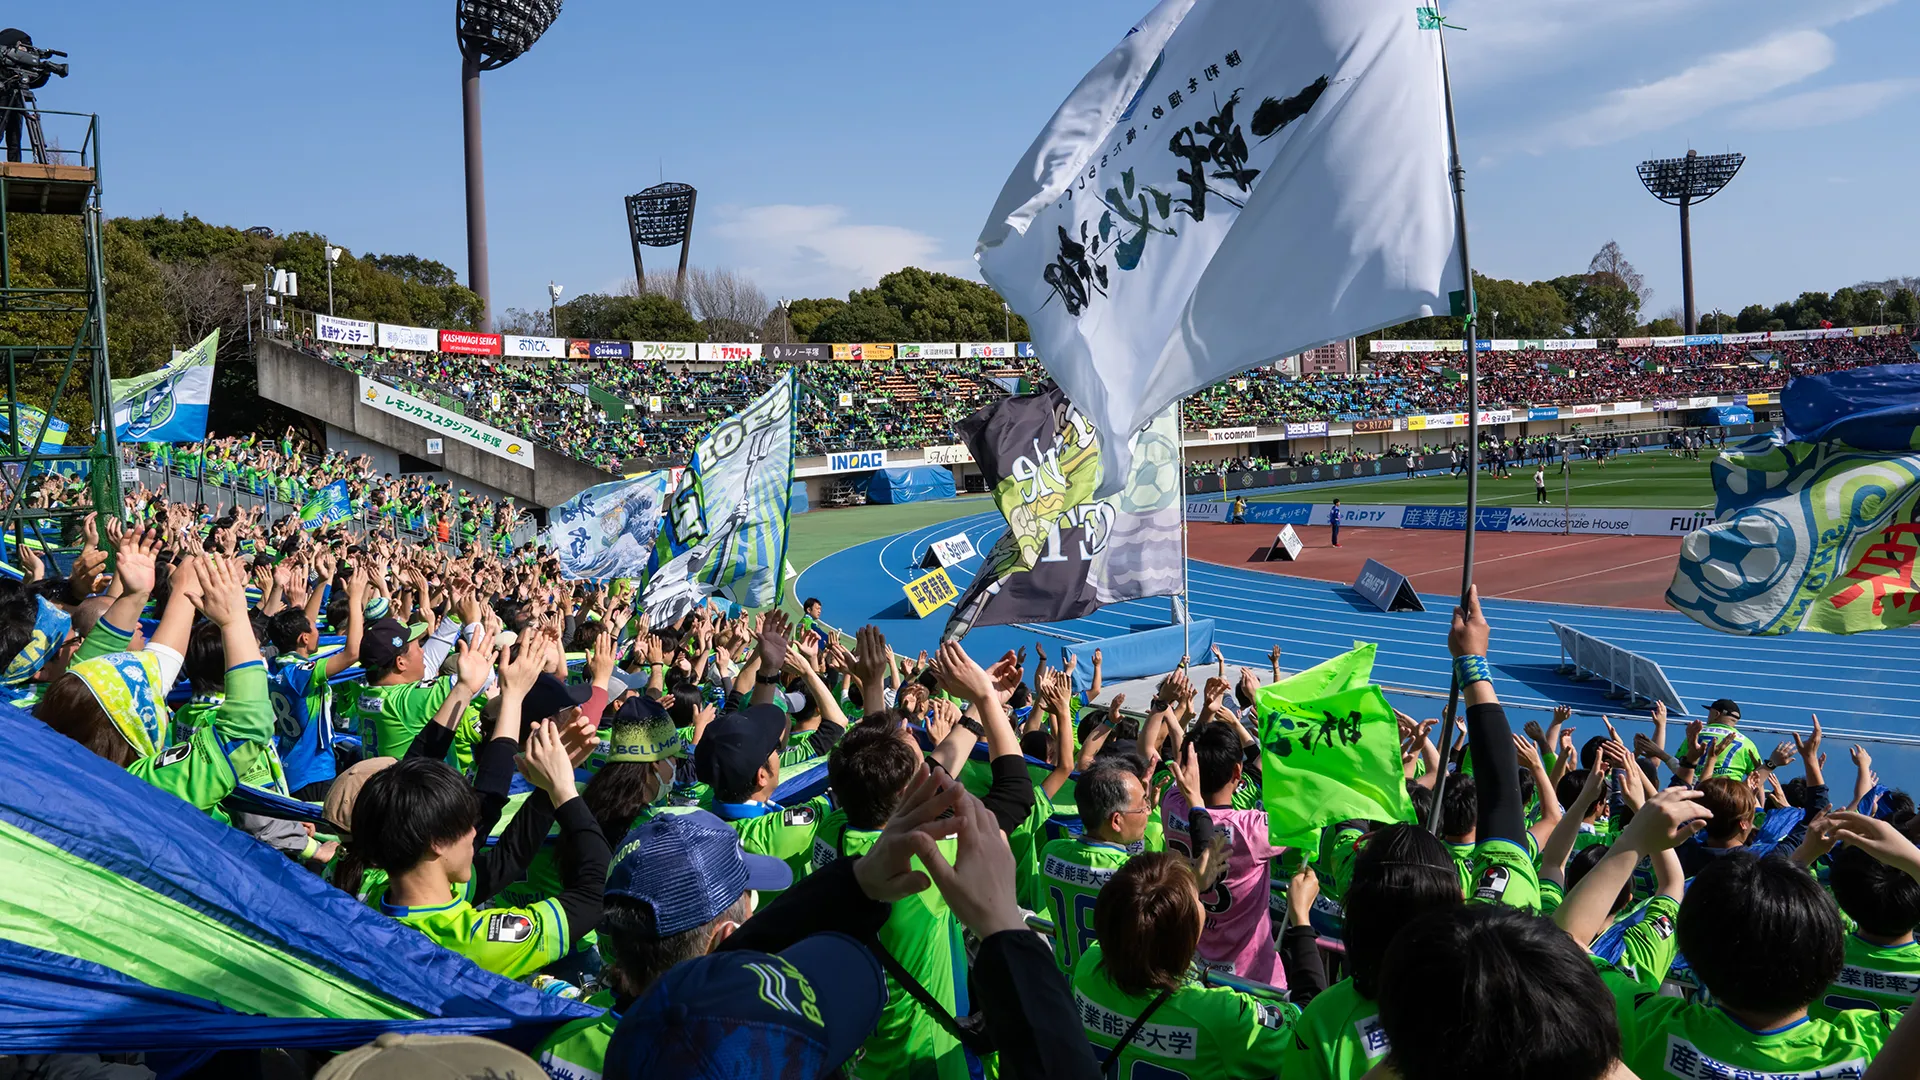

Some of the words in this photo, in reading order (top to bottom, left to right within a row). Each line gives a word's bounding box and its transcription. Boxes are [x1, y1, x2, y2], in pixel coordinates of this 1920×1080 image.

[321, 325, 369, 342] 横浜サンミラー
[443, 334, 478, 345] KASHIWAGI
[479, 337, 497, 346] SEIKA
[721, 347, 752, 359] アスリート
[785, 347, 819, 357] ルノー平塚
[385, 395, 502, 448] レモンガススタジアム平塚
[1369, 420, 1392, 429] RIZAP
[1214, 432, 1223, 441] TK
[1224, 429, 1256, 440] COMPANY
[832, 452, 882, 471] INOAC
[1403, 508, 1508, 529] 産業能率大学
[1528, 517, 1588, 529] Mackenzie
[1592, 518, 1629, 530] House
